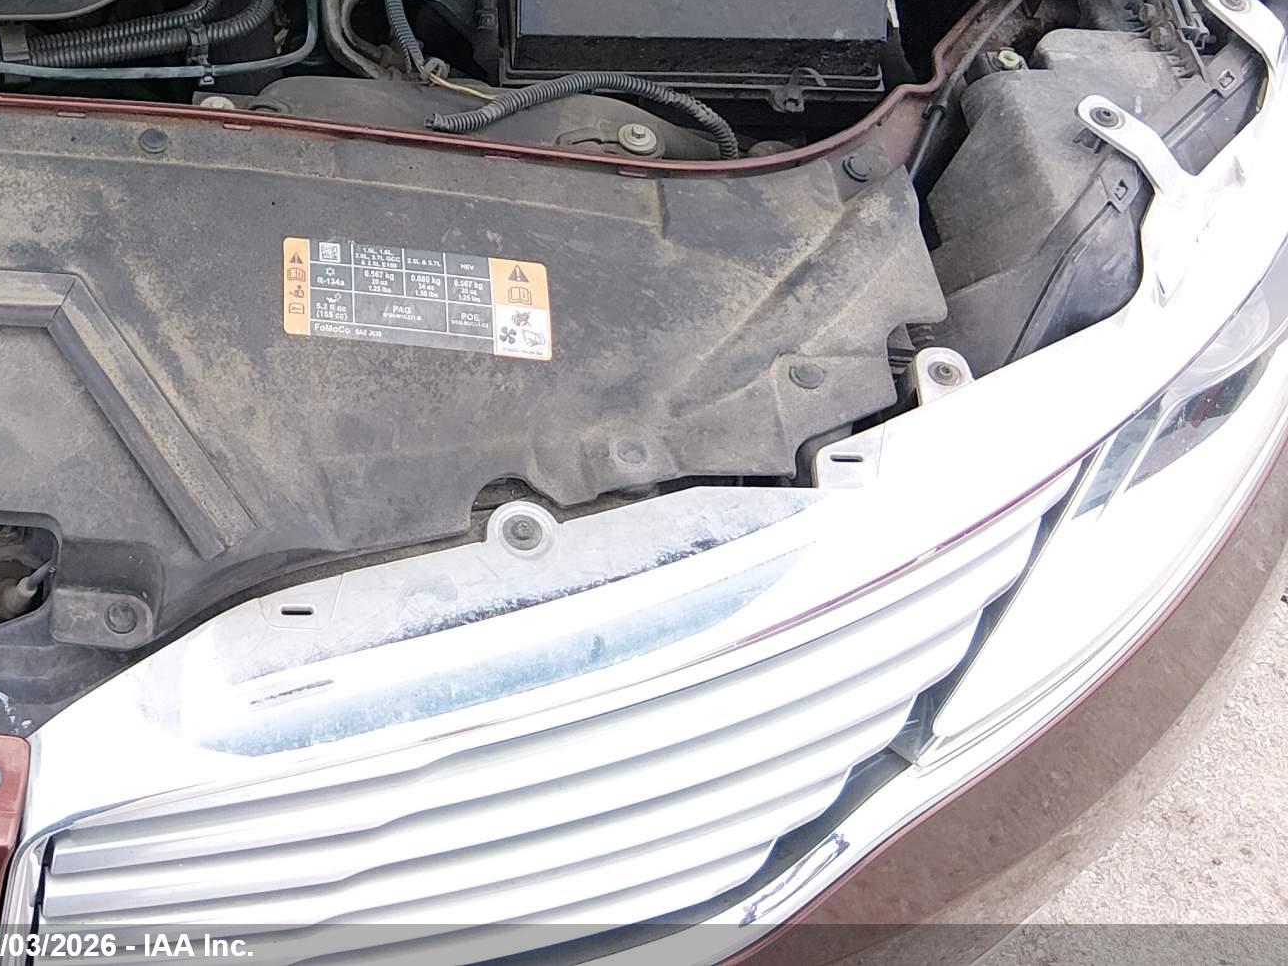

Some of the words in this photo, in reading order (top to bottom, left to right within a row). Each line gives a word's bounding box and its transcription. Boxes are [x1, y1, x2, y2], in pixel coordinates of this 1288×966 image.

[316, 276, 345, 286] R-134a
[392, 305, 412, 314] PAG
[460, 312, 481, 322] POE
[313, 323, 351, 335] FoMoCo
